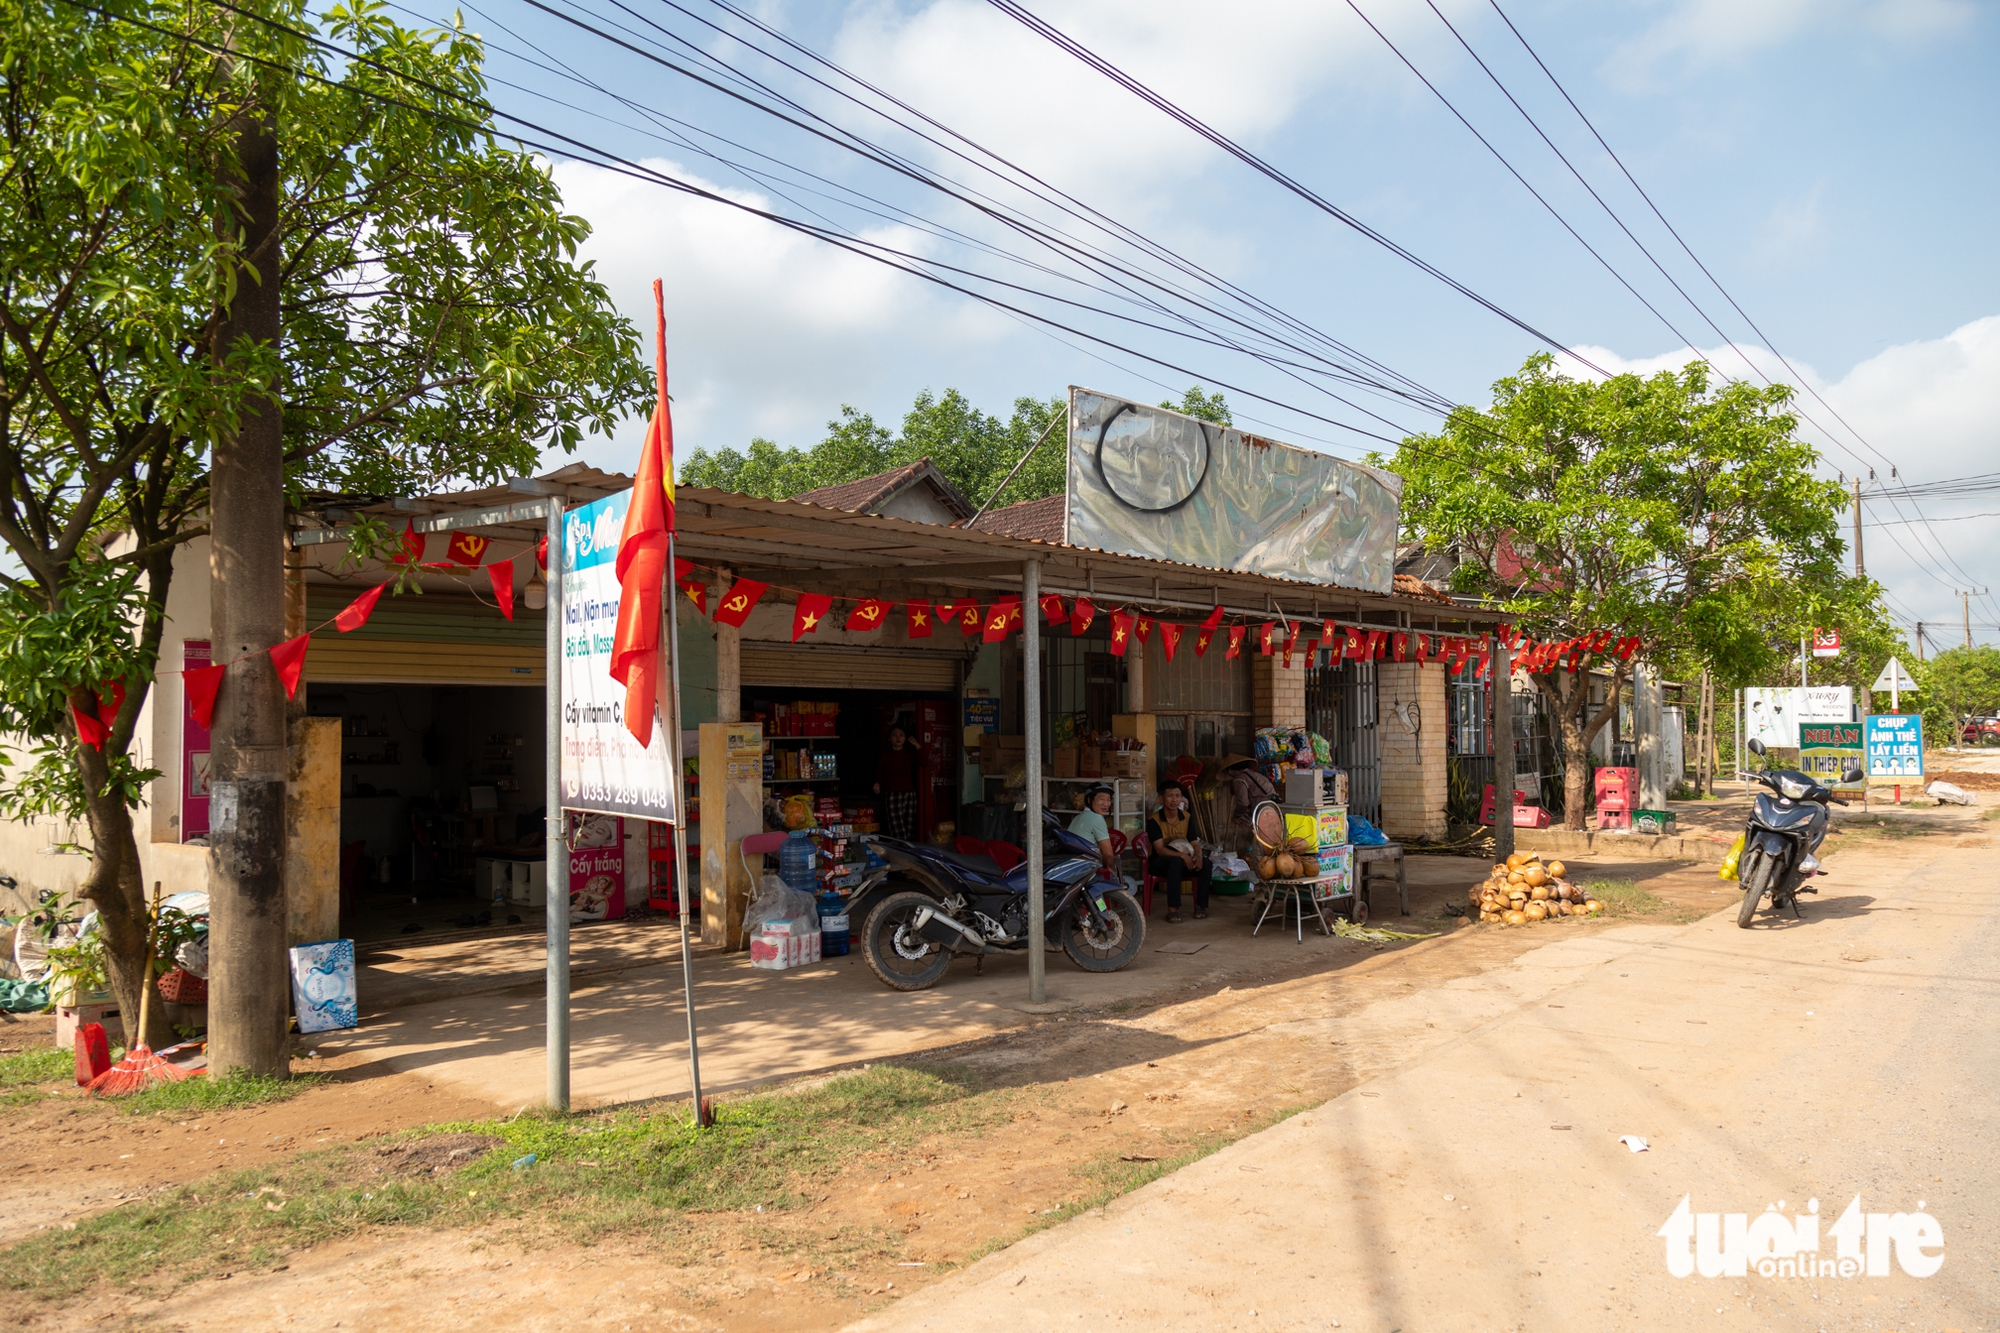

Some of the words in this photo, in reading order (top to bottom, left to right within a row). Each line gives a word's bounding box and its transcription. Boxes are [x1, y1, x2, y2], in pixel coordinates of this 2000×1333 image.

[566, 602, 582, 626] Nail,
[584, 599, 600, 627] Nặn
[565, 697, 581, 728] Cấy
[582, 702, 611, 724] vitamin
[613, 701, 623, 727] C,
[1877, 717, 1908, 730] CHỤP
[565, 736, 585, 763] Trang
[587, 728, 609, 762] điểm,
[1803, 725, 1860, 747] NHẬN
[1870, 728, 1894, 742] ẢNH
[1895, 728, 1917, 742] THẺ
[1870, 742, 1891, 755] LẤY
[1802, 756, 1812, 772] IN
[1813, 753, 1838, 776] THIỆP
[582, 782, 611, 802] 0353
[614, 785, 638, 805] 289
[642, 786, 668, 809] 048
[570, 854, 592, 876] Cấy
[594, 851, 623, 874] trắng
